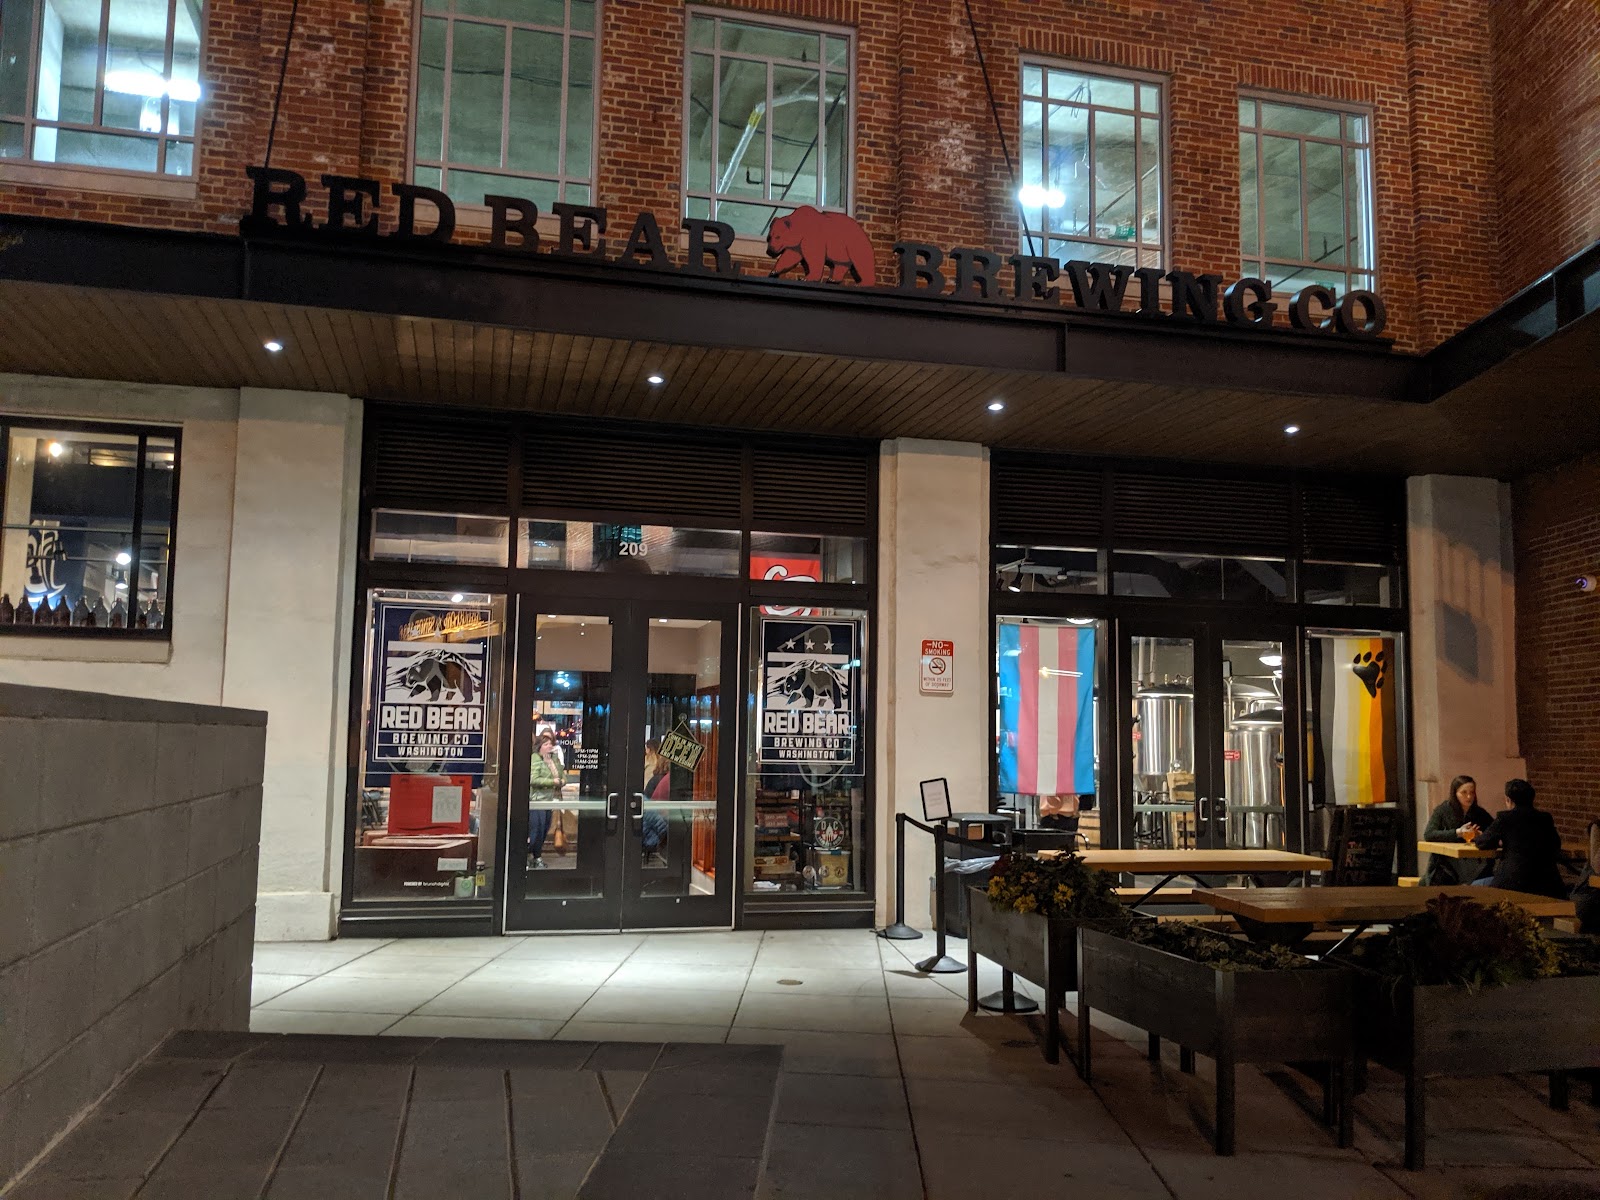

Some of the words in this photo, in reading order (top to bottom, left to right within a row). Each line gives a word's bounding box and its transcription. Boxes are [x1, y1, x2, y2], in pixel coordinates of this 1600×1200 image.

[240, 165, 456, 244] RED
[484, 194, 739, 280] BEAR
[892, 241, 1279, 328] BREWING
[1288, 283, 1388, 338] CO
[619, 541, 648, 556] 209
[931, 641, 944, 649] NO
[924, 648, 951, 656] SMOKING
[381, 705, 423, 729] RED
[426, 706, 481, 730] BEAR
[764, 711, 800, 734] RED
[802, 712, 849, 735] BEAR
[392, 732, 449, 745] BREWING
[454, 734, 469, 745] CO
[774, 737, 822, 748] BREWING
[826, 738, 840, 748] CO
[397, 746, 463, 757] WASHINGTON
[660, 737, 702, 766] OPEN
[778, 749, 835, 759] WASHINGTON
